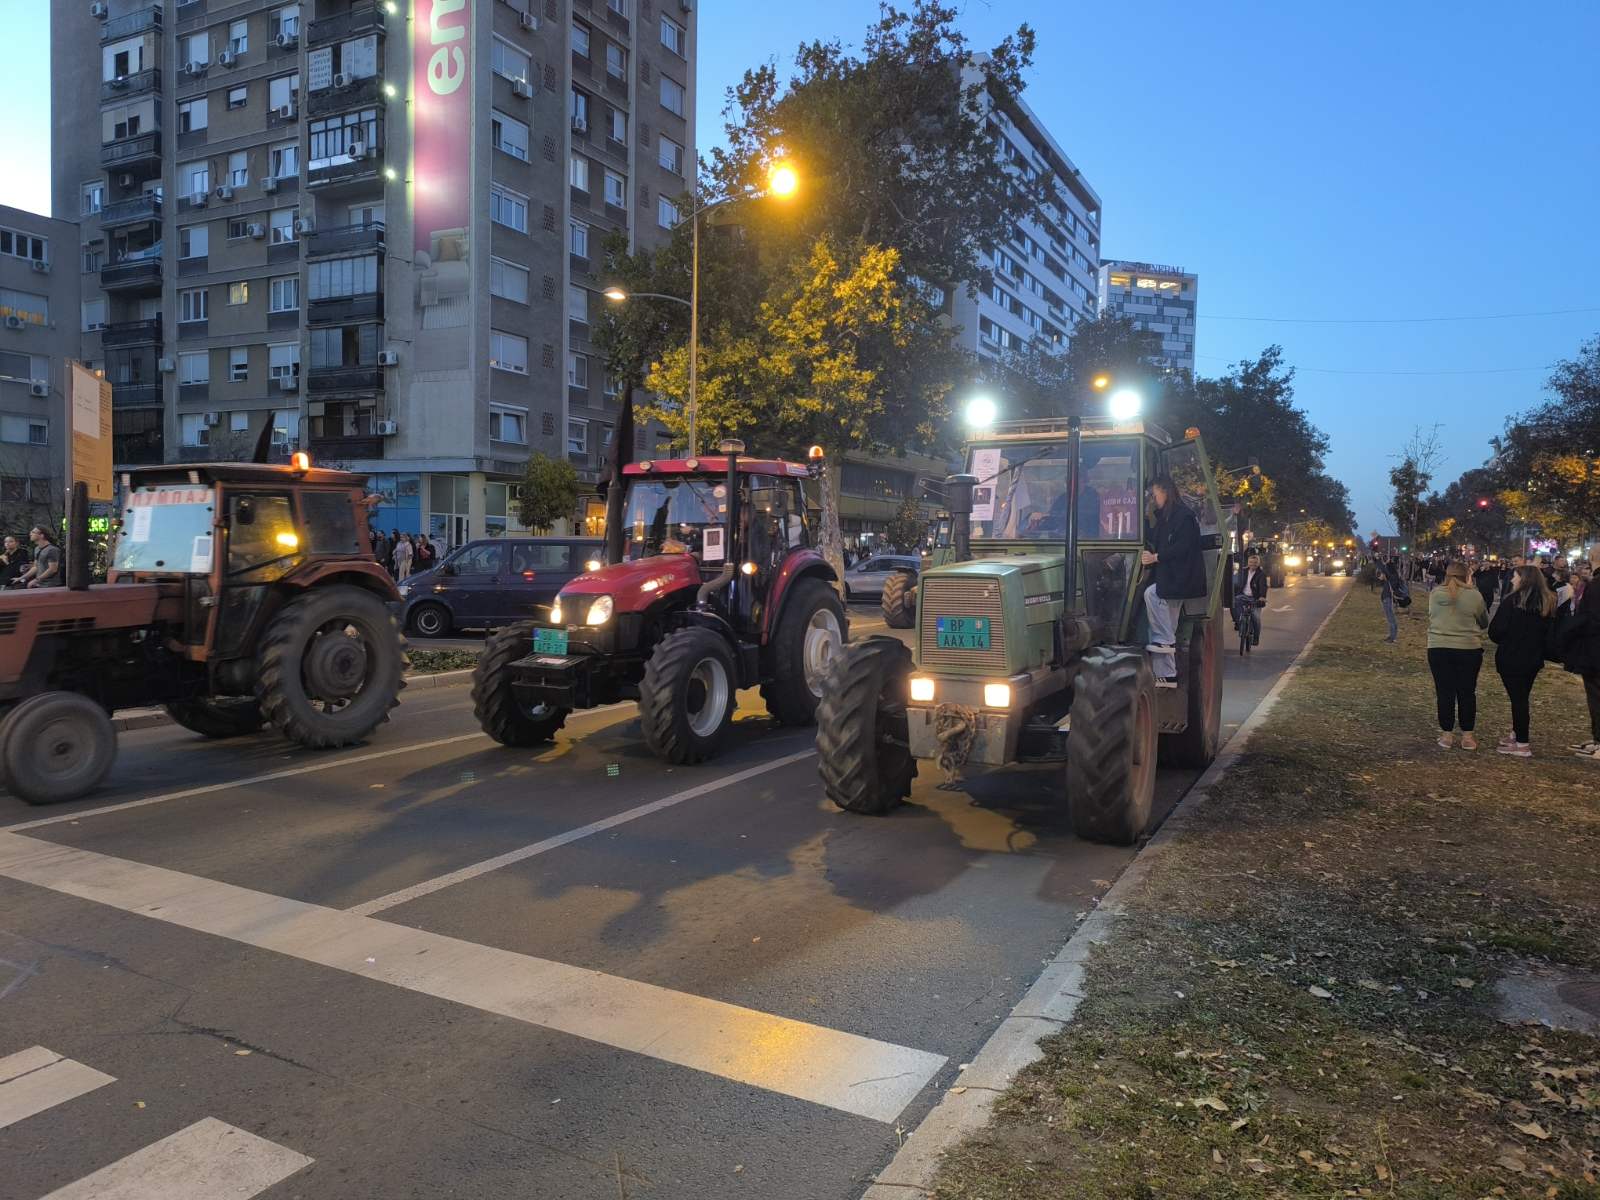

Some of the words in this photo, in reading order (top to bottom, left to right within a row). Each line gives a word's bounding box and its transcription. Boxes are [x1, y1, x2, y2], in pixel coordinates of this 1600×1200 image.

[951, 619, 965, 632] BP
[944, 634, 965, 647] AAX
[971, 635, 984, 648] 14
